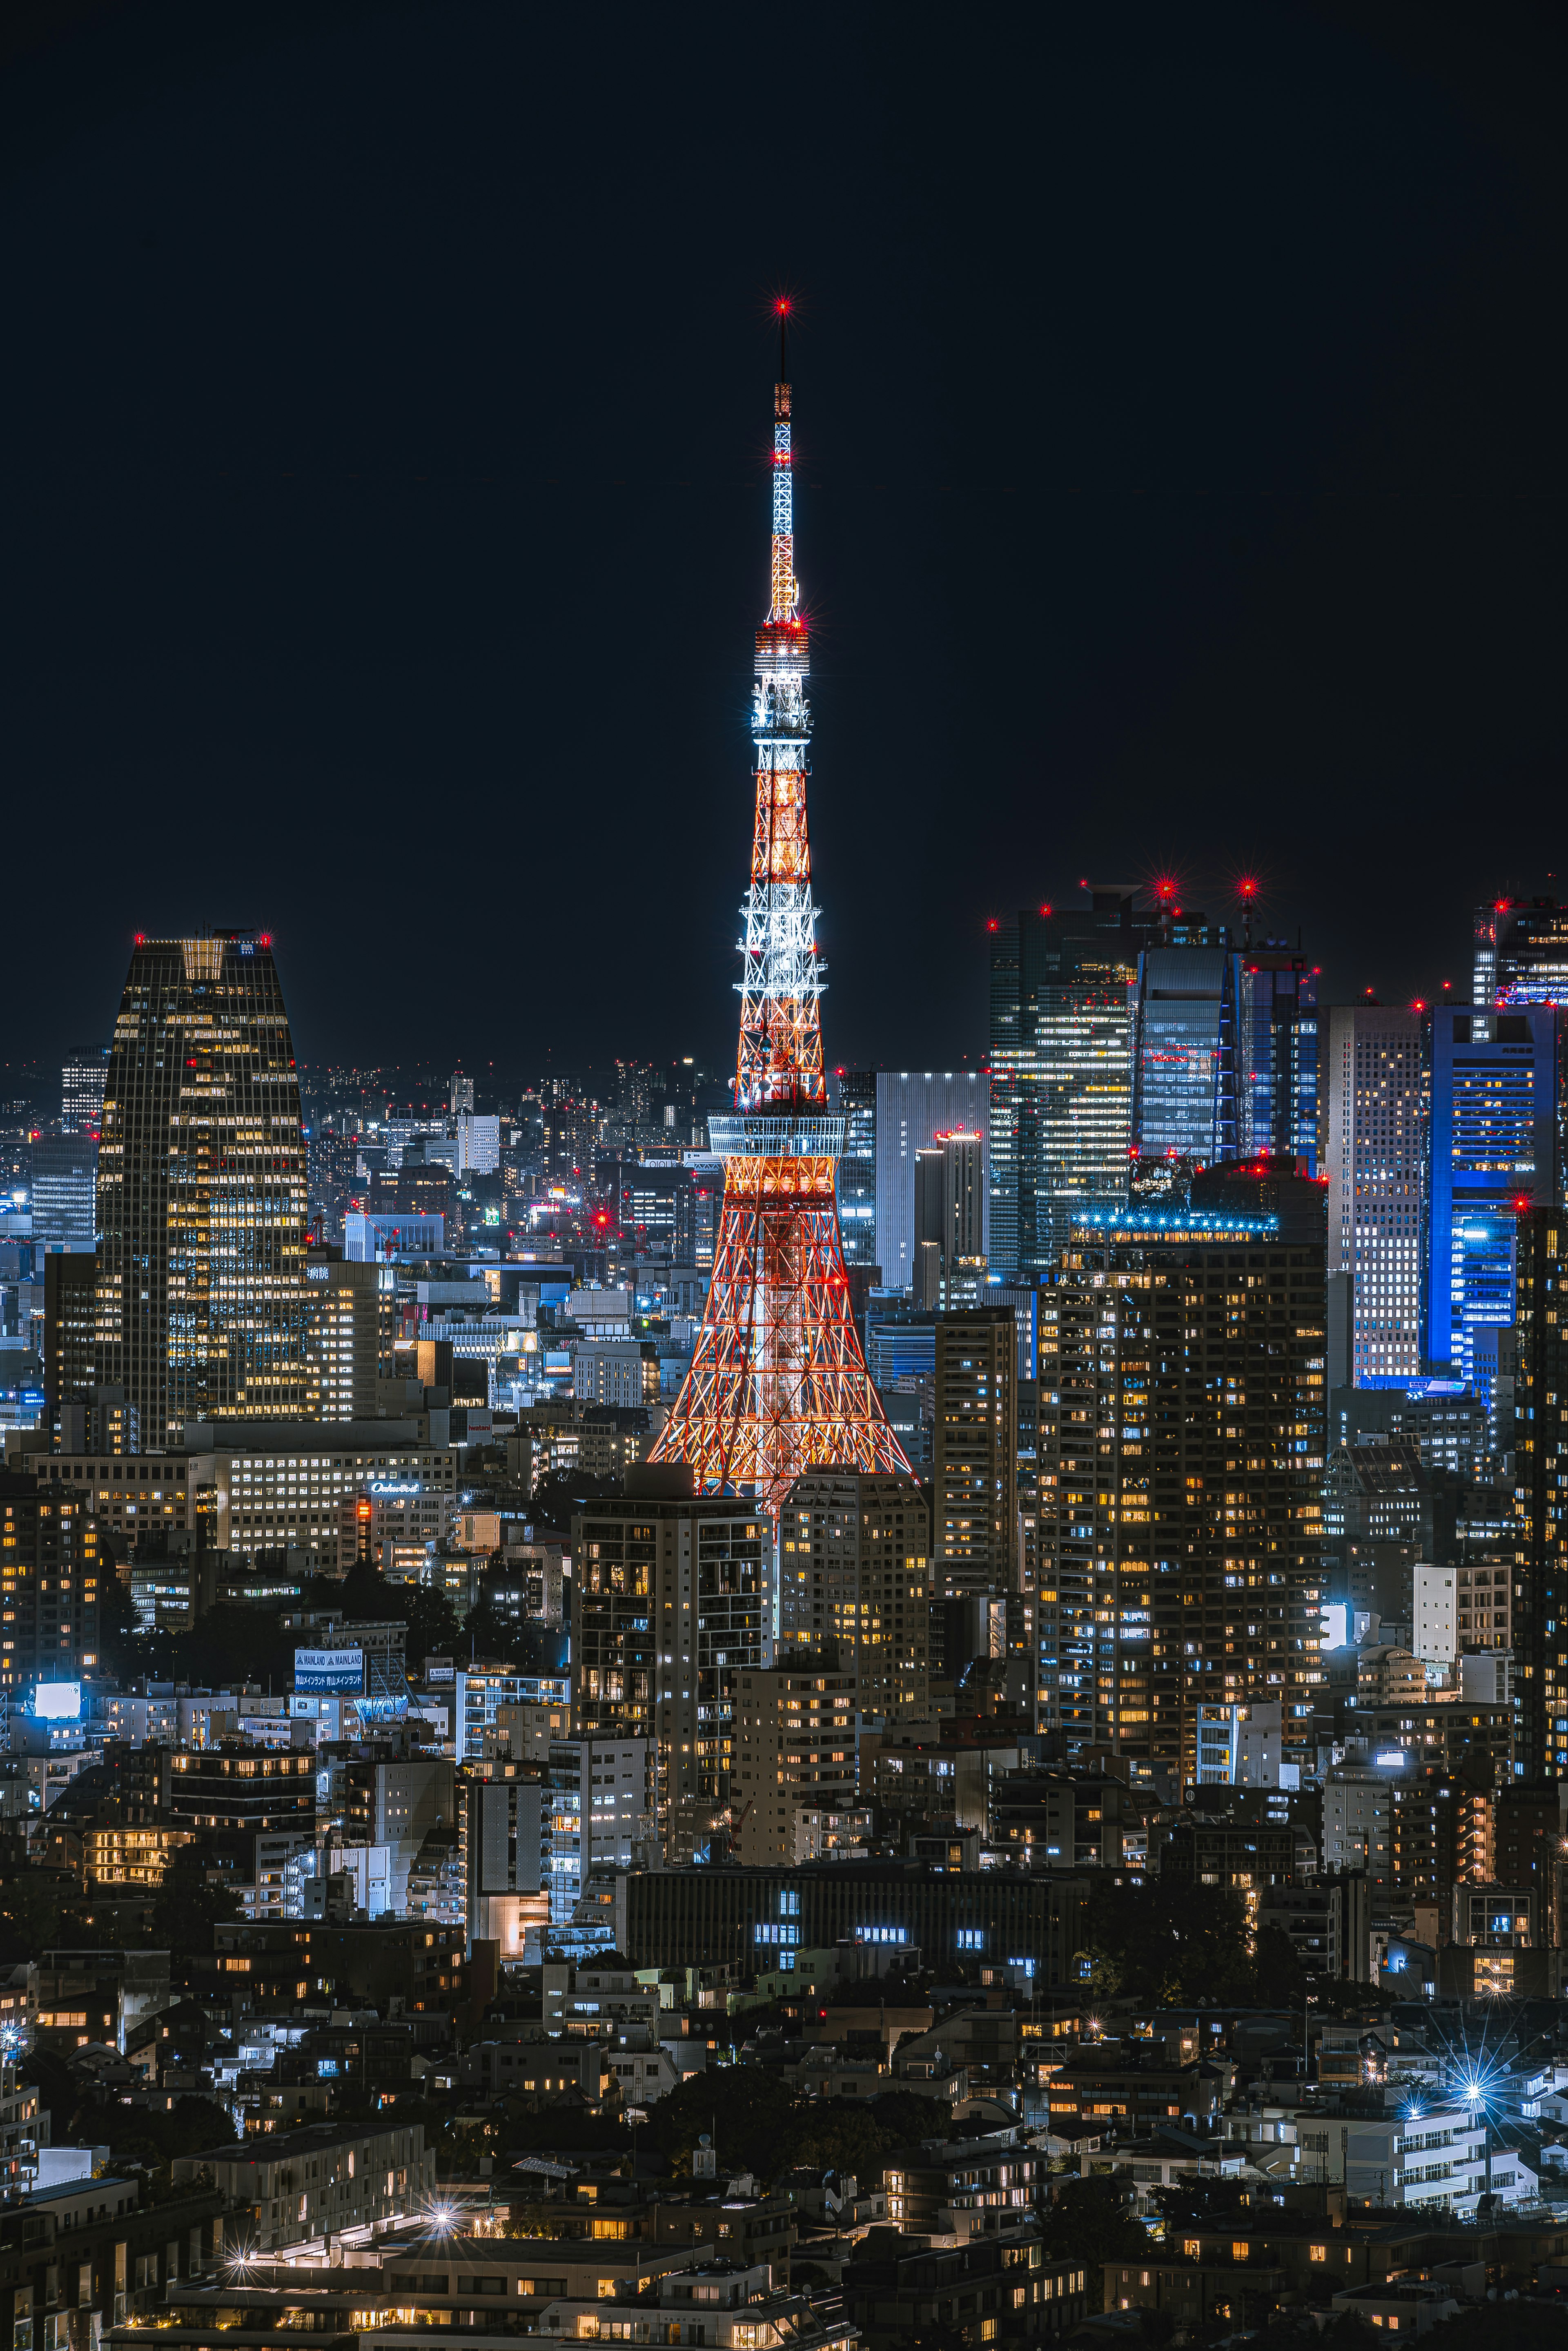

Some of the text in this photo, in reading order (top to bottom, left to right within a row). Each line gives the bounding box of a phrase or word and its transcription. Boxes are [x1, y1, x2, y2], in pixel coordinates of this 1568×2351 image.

[371, 1482, 419, 1493] Oakwood
[304, 1655, 325, 1666] MAINLAND
[335, 1654, 361, 1666] MAINLAND
[296, 1675, 325, 1686] 青山メインランド
[327, 1675, 361, 1687] 青山メインランド
